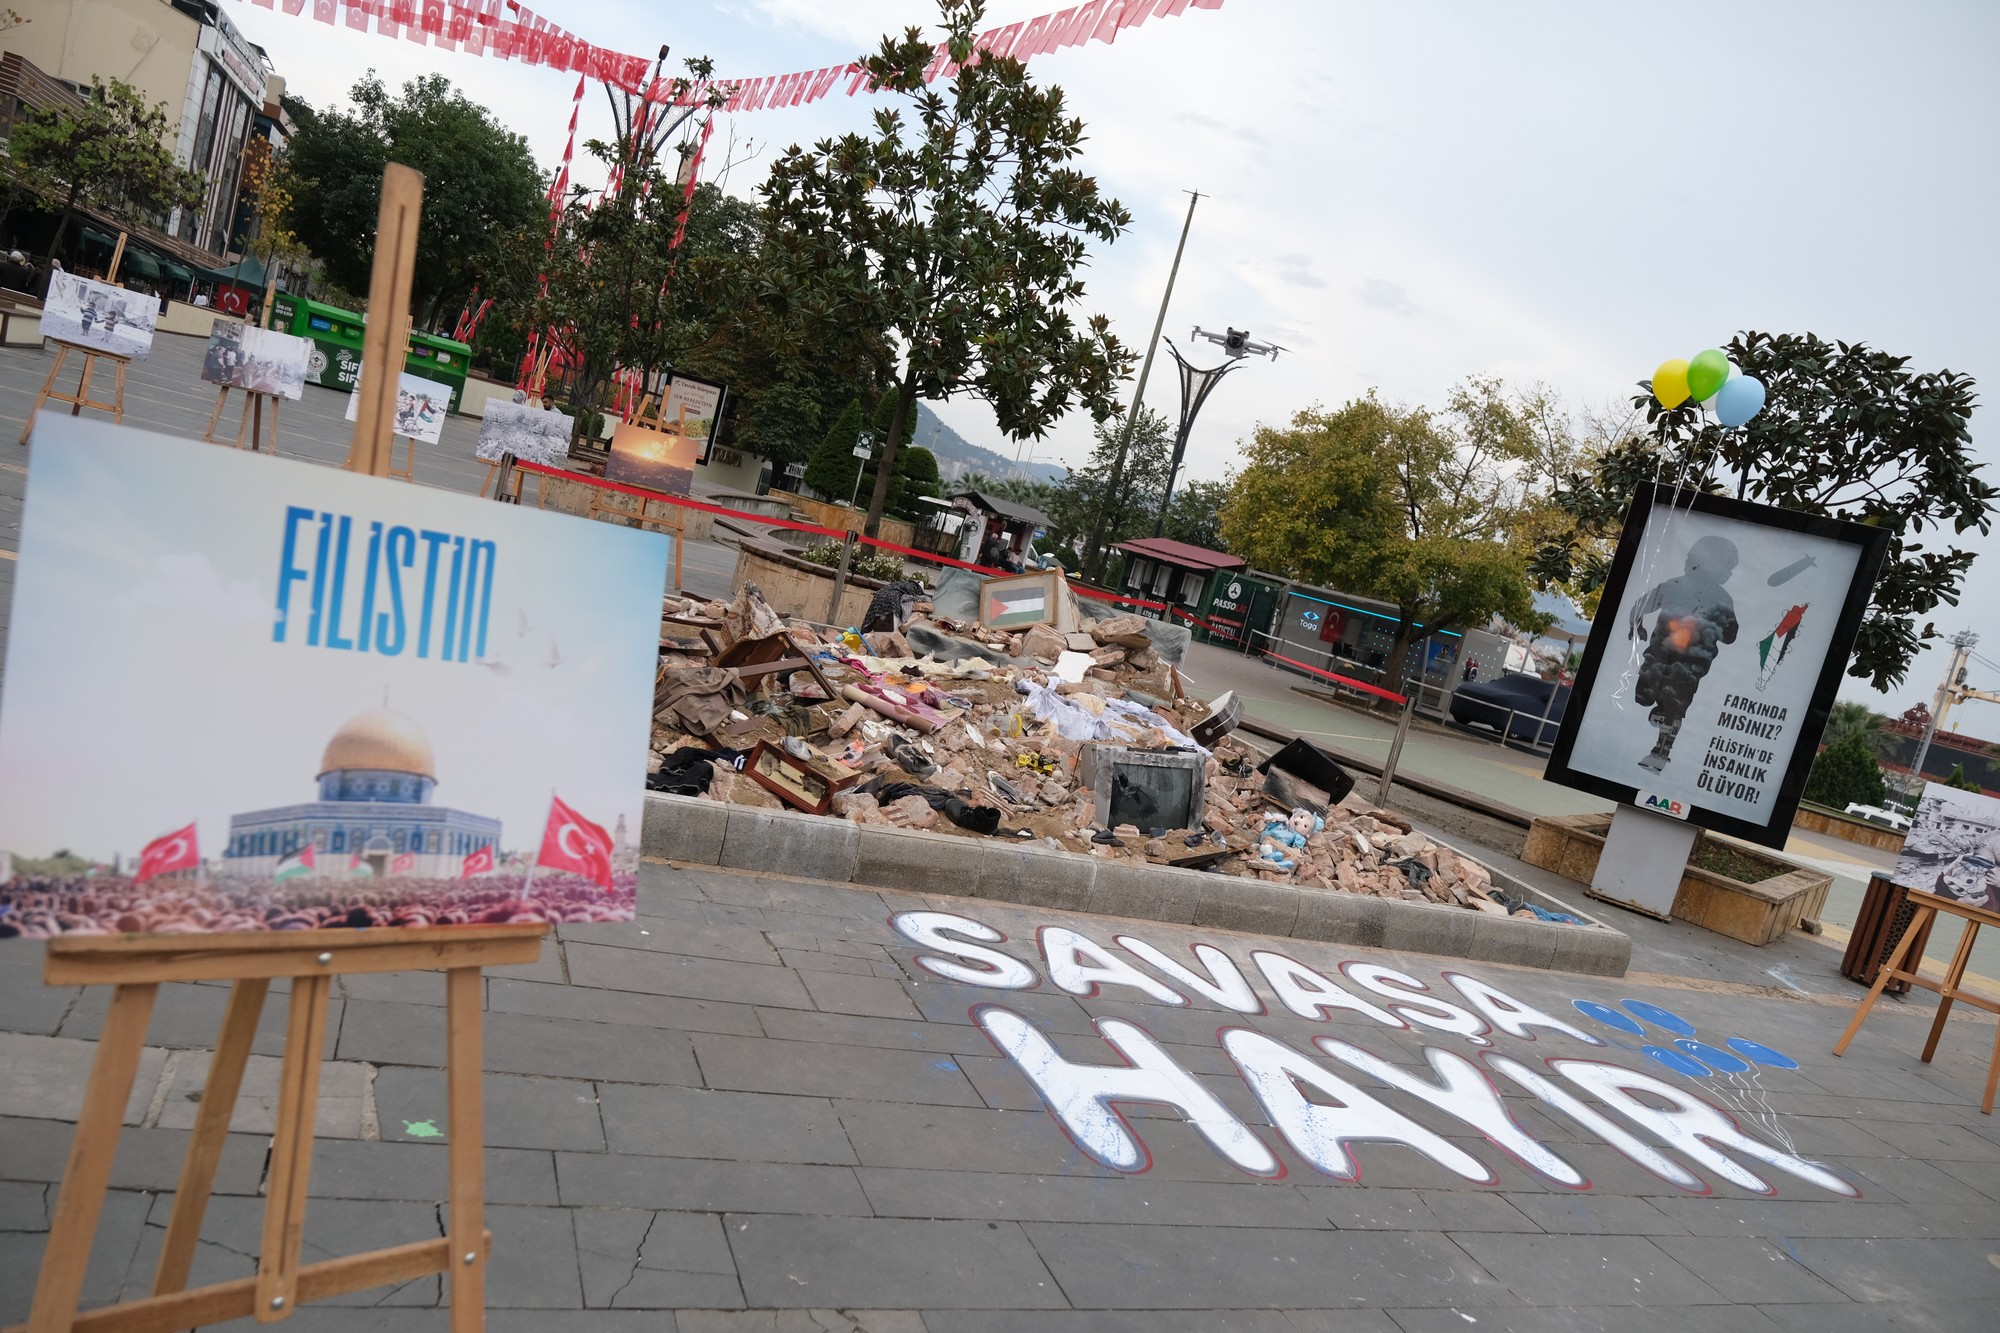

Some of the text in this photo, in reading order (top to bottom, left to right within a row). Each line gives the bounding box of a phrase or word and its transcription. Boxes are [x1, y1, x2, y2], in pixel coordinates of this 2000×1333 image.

[338, 371, 357, 384] SIF
[340, 360, 359, 372] SIF
[1300, 619, 1318, 631] Togg
[1723, 694, 1787, 721] FARKINDA
[1717, 712, 1782, 740] MISINIZ?
[1709, 736, 1774, 764] FİLİSTİN'DE
[1703, 750, 1767, 783] İNSANLIK
[1697, 769, 1760, 804] ÖLÜYOR!
[1645, 794, 1682, 815] AAR
[887, 910, 1608, 1047] SAVAŞA
[967, 1003, 1863, 1198] HAYIR
